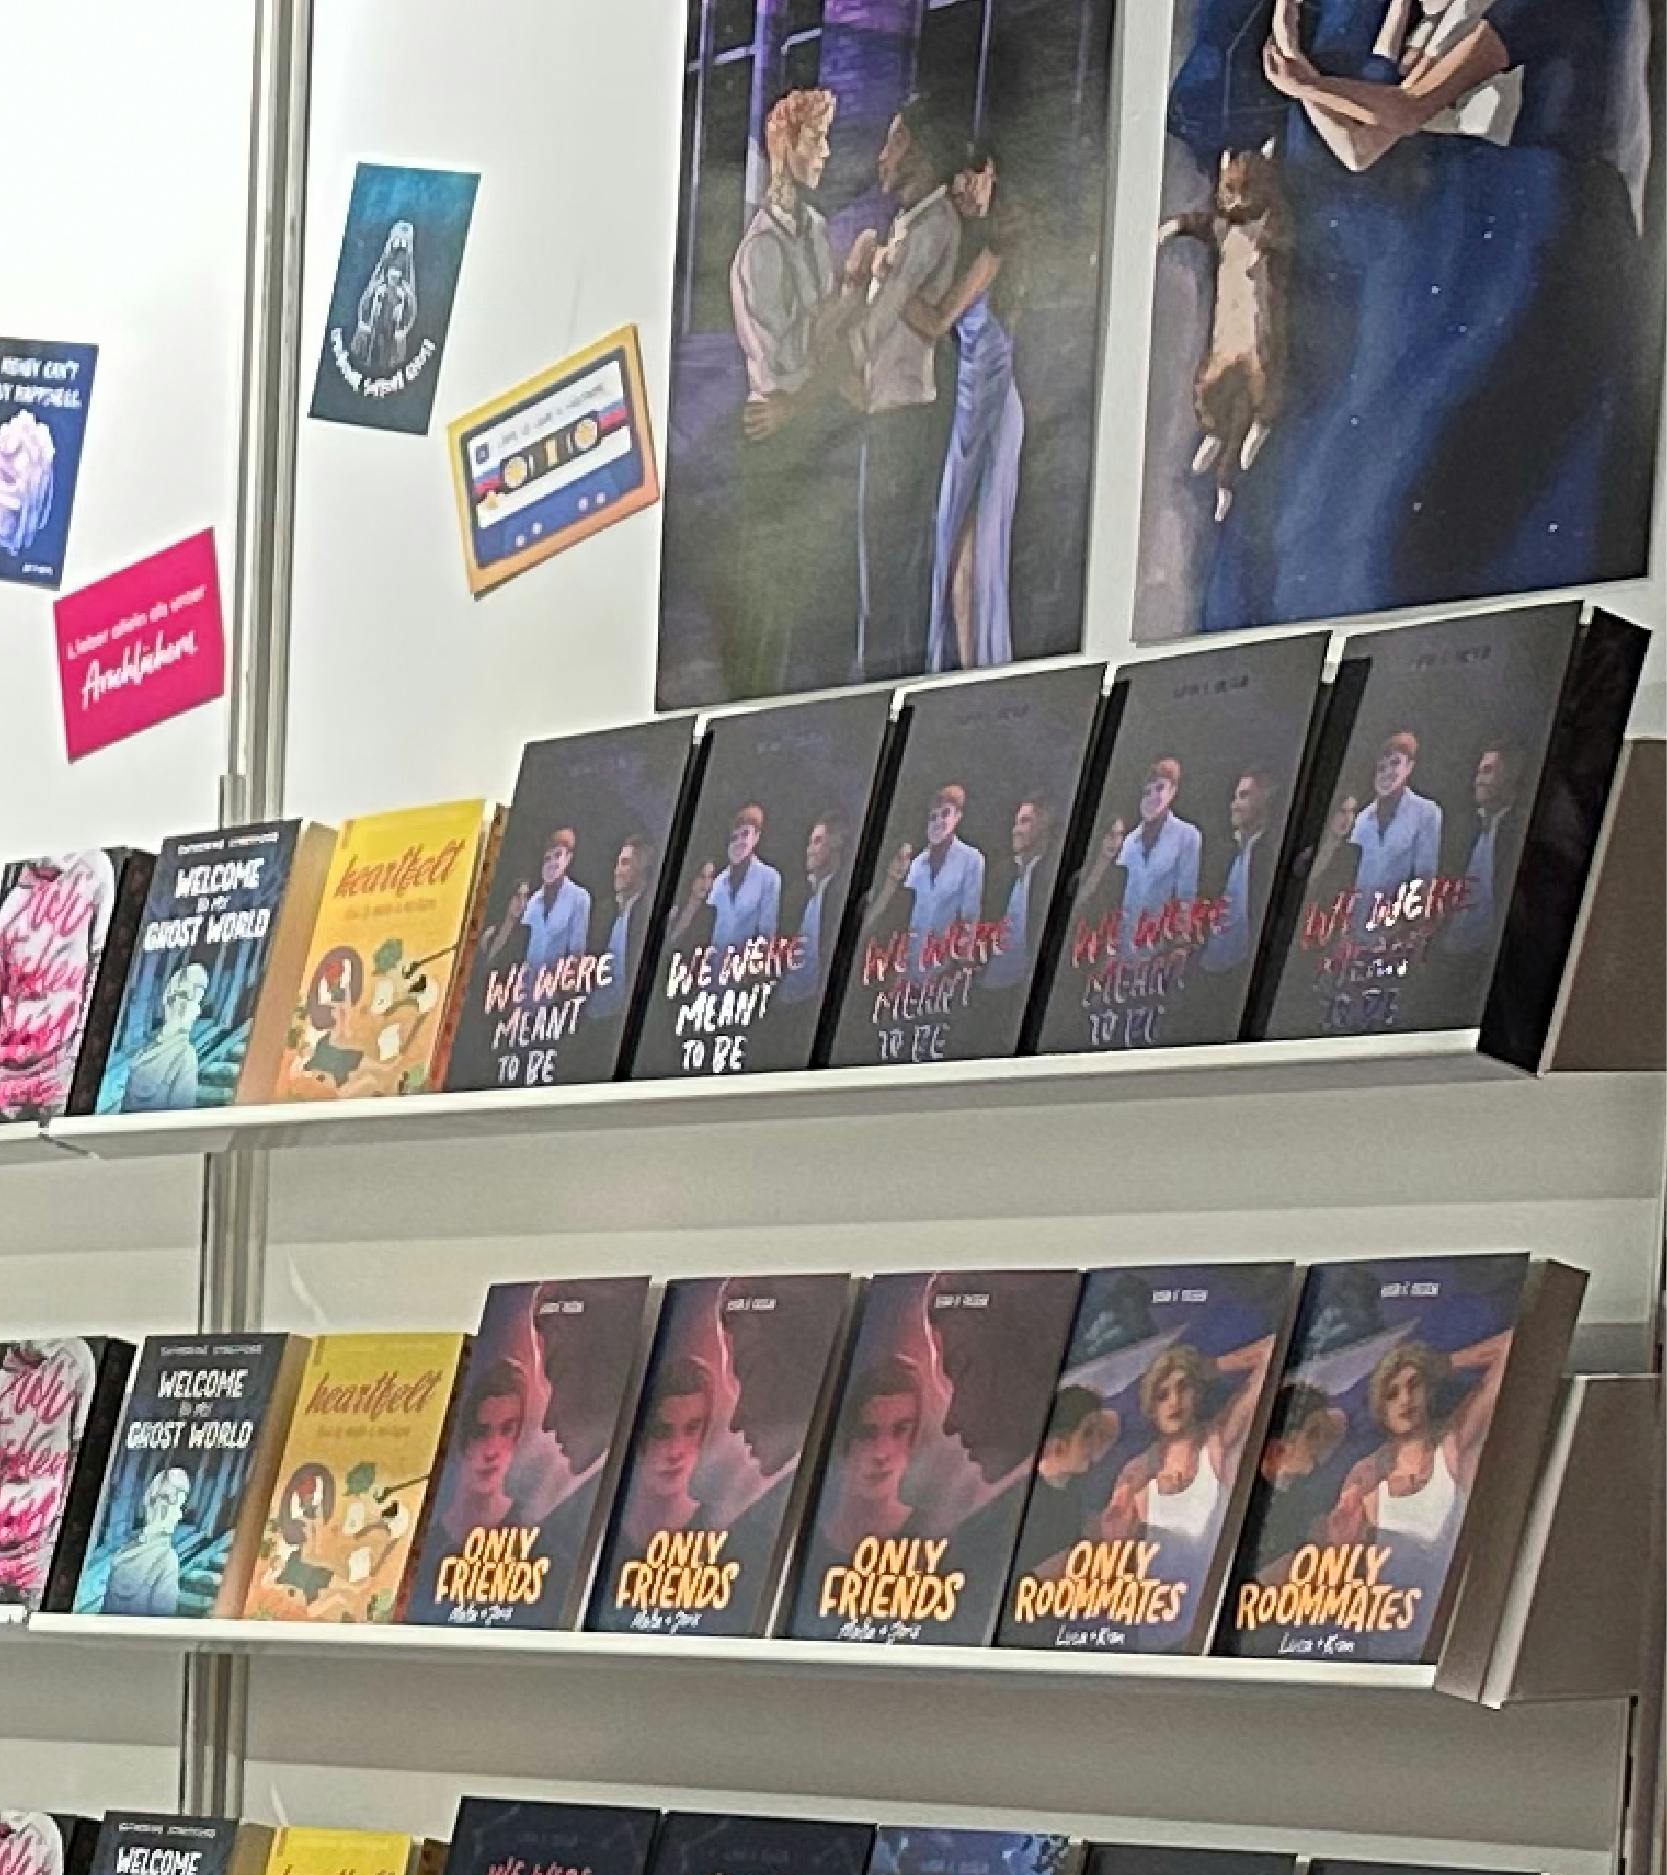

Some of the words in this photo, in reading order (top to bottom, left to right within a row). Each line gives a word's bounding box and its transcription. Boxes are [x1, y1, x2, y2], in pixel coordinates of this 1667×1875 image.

[174, 856, 268, 899] WELCOME
[335, 838, 466, 900] heartfelt
[143, 911, 202, 952] GHOST
[205, 908, 271, 944] WORLD
[483, 967, 532, 1010] WE
[534, 954, 614, 1001] WERE
[491, 998, 586, 1051] MEANT
[498, 1056, 520, 1082] TO
[524, 1048, 556, 1085] BE
[463, 1526, 542, 1564] ONLY
[1065, 1539, 1161, 1580] ONLY
[434, 1560, 550, 1607] FRIENDS
[1013, 1575, 1188, 1628] ROOMMATES
[1235, 1580, 1421, 1632] ROOMMATES
